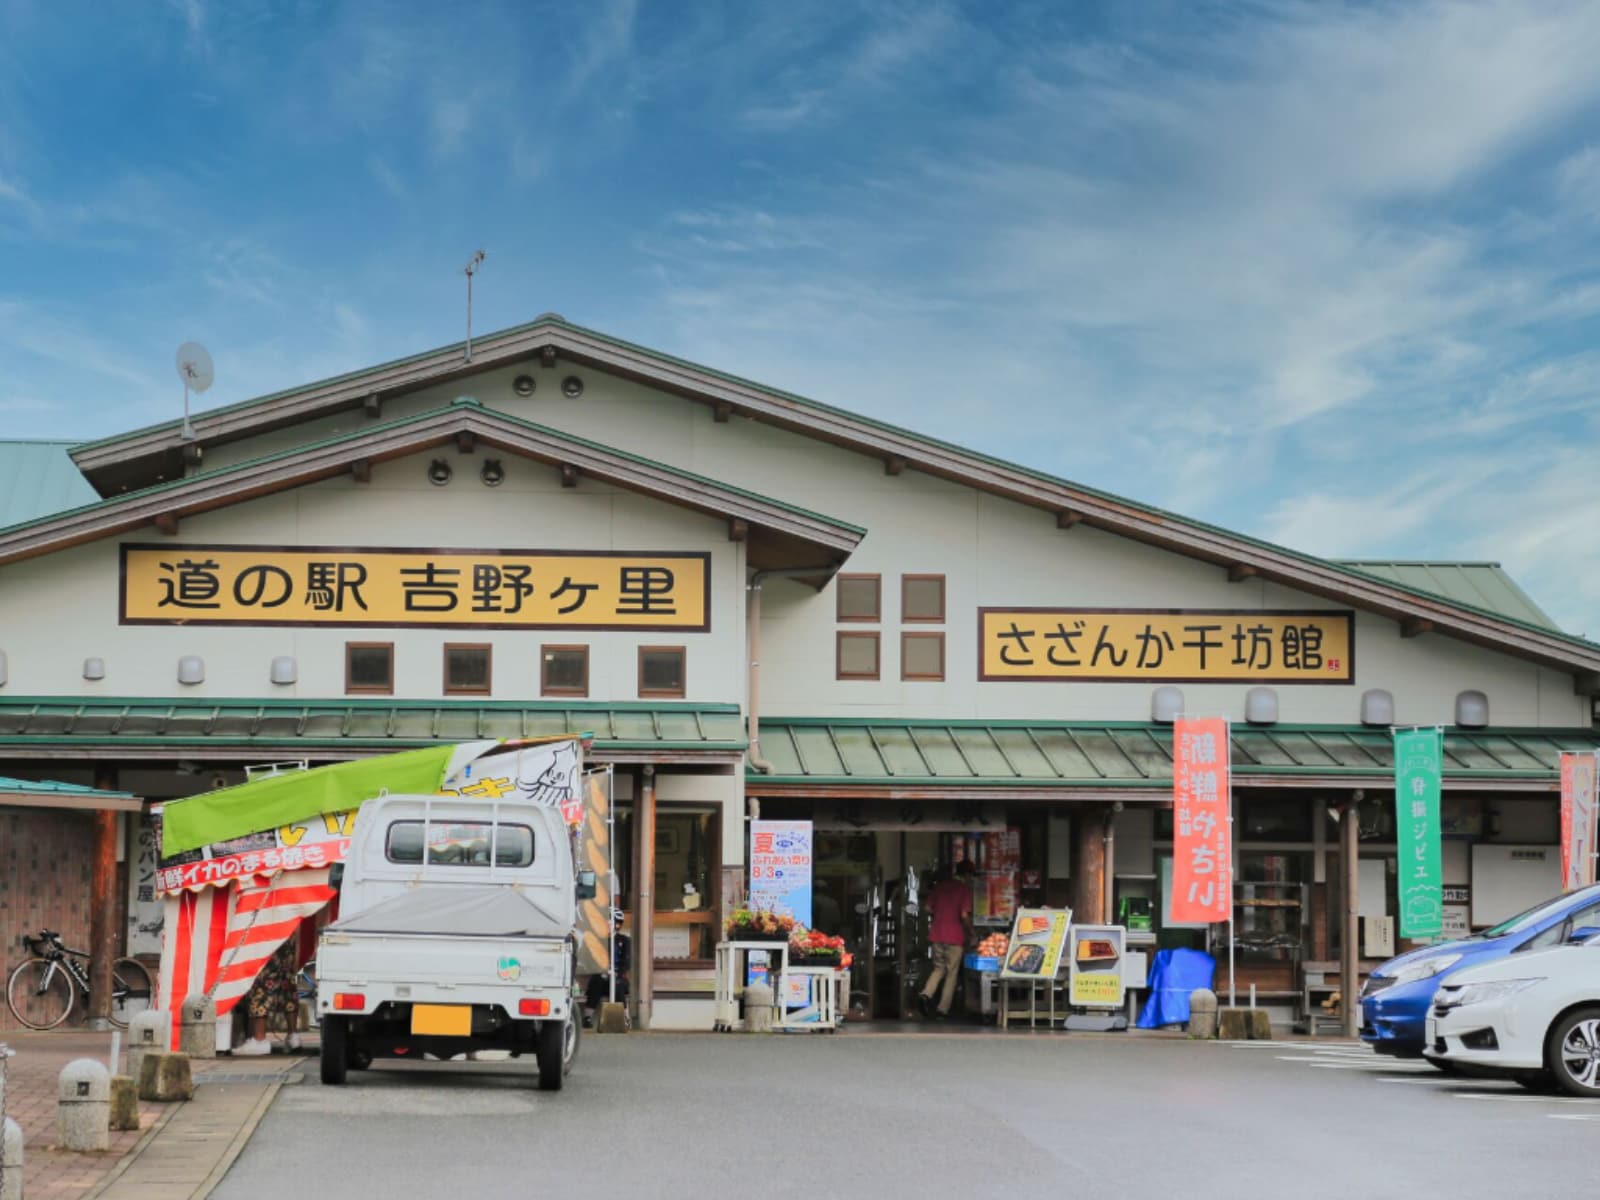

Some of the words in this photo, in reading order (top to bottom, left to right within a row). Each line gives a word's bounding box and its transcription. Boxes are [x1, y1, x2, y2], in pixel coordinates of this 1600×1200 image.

[158, 560, 368, 612] 道の駅
[997, 620, 1323, 670] さざんか千坊館
[753, 832, 775, 854] 夏
